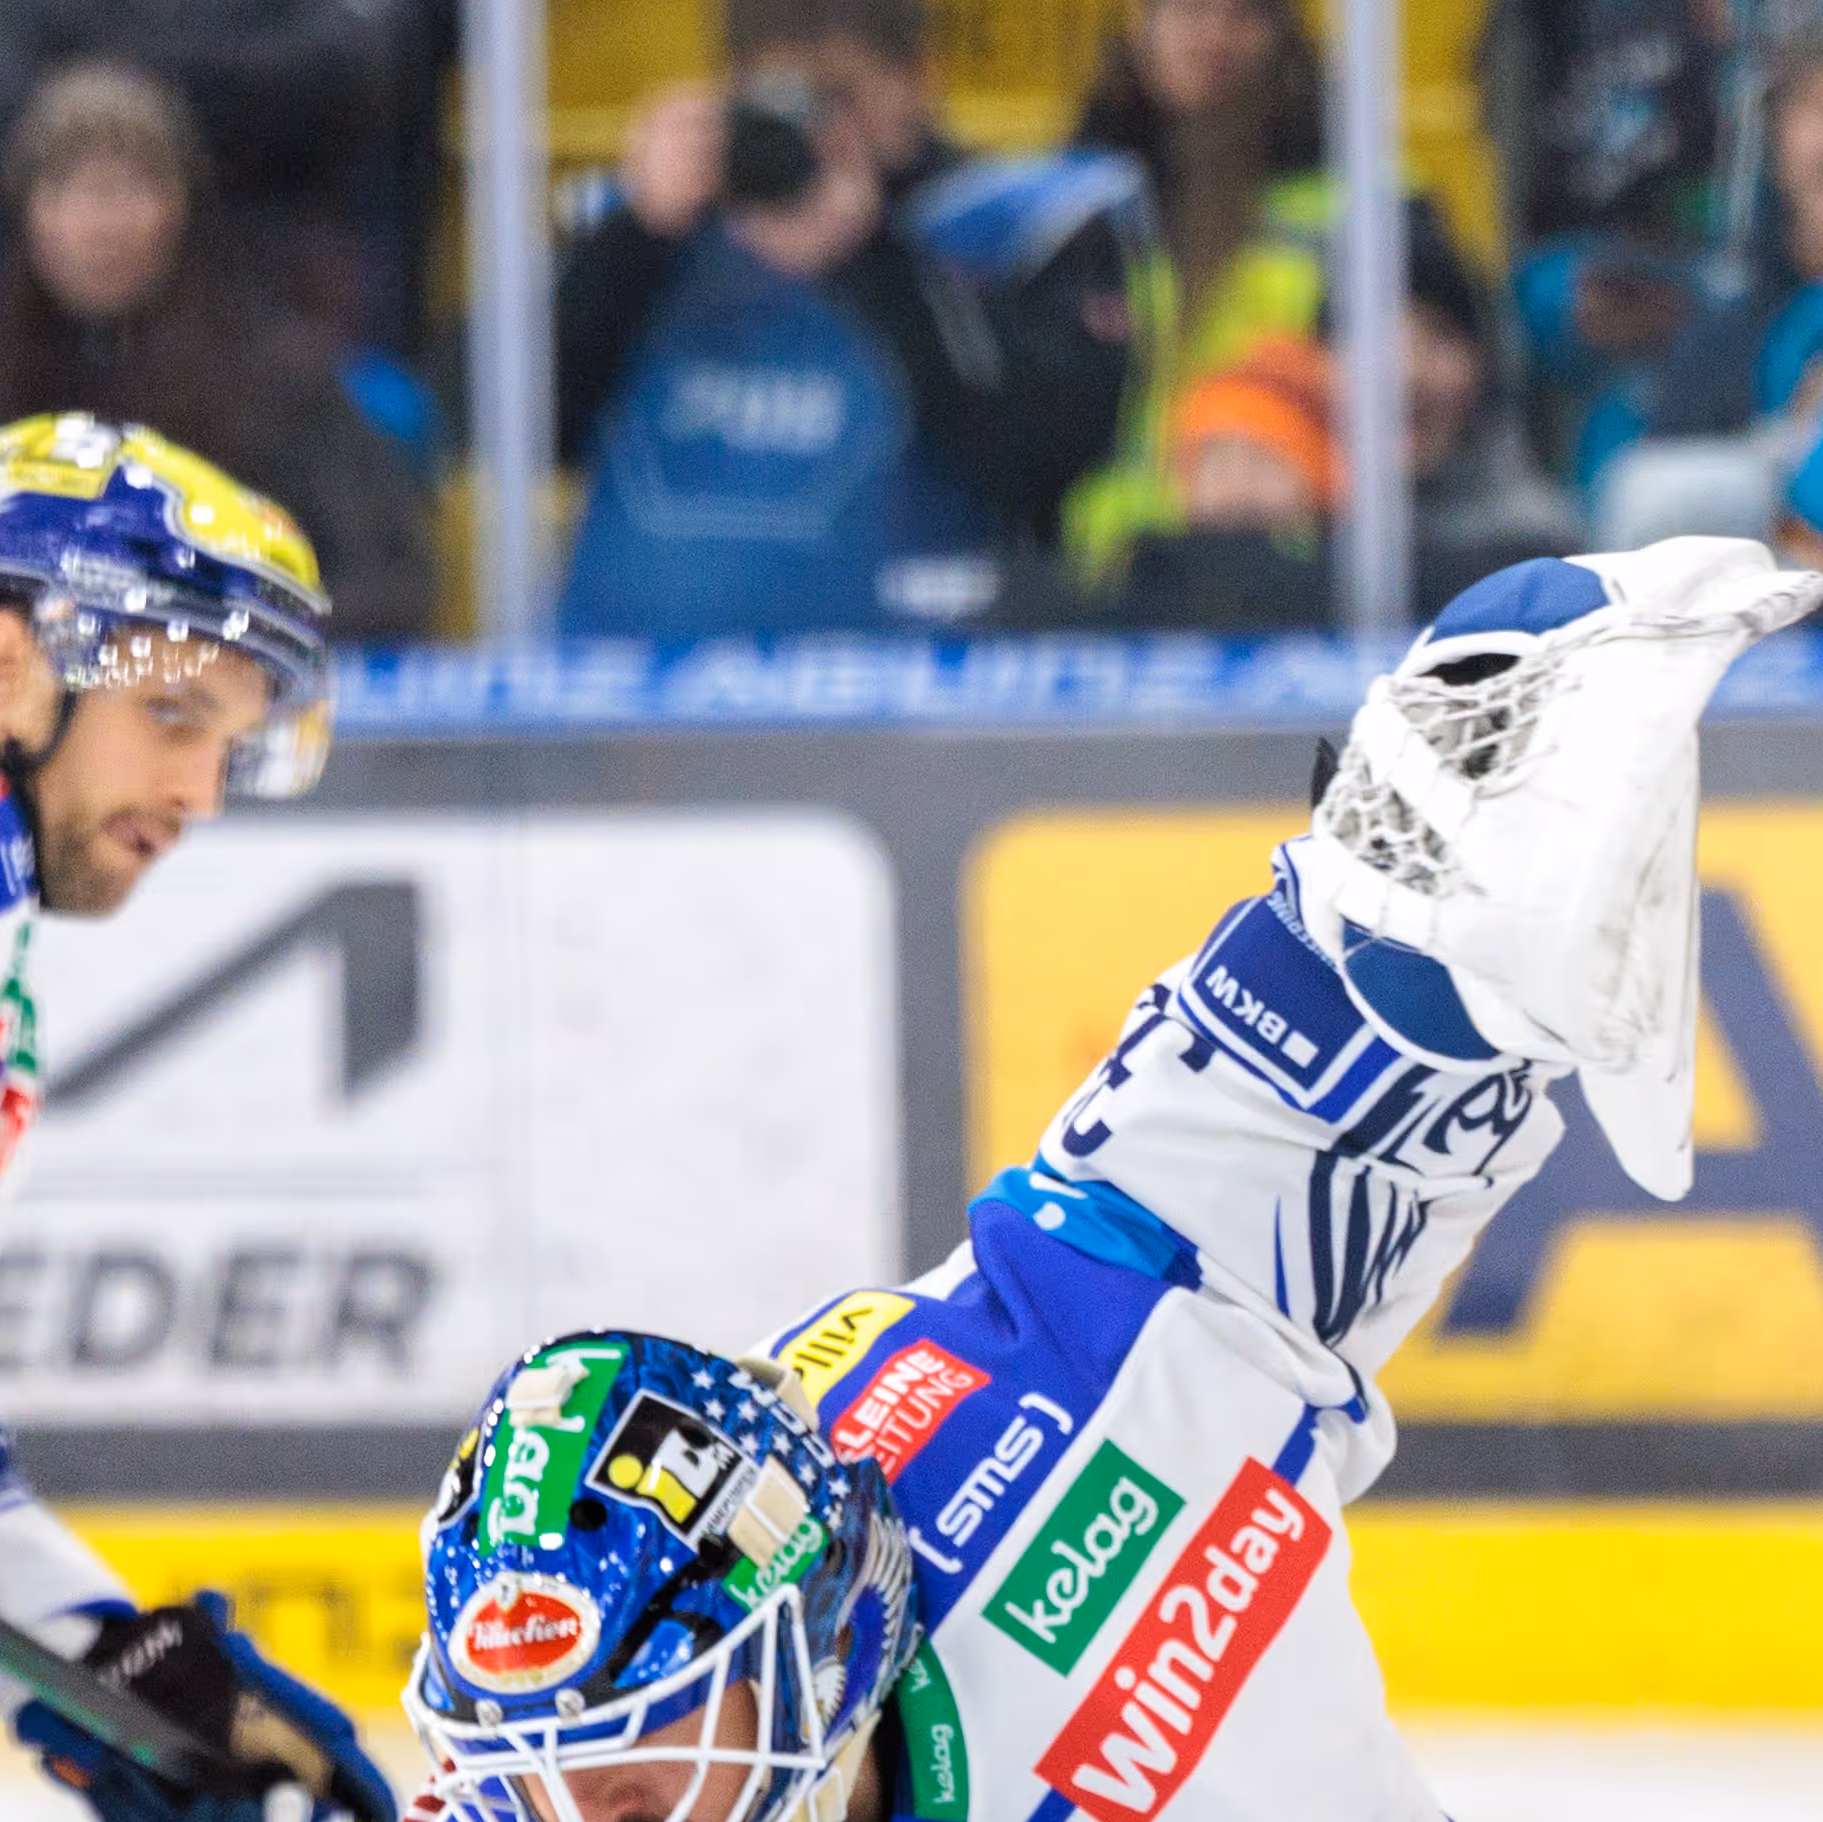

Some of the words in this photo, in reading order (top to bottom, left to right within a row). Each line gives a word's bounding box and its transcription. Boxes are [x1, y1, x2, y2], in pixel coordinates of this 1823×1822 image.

[1205, 964, 1289, 1046] BKW
[792, 1306, 875, 1381] vill
[1006, 1476, 1161, 1645] kelag
[1072, 1486, 1306, 1814] win2day
